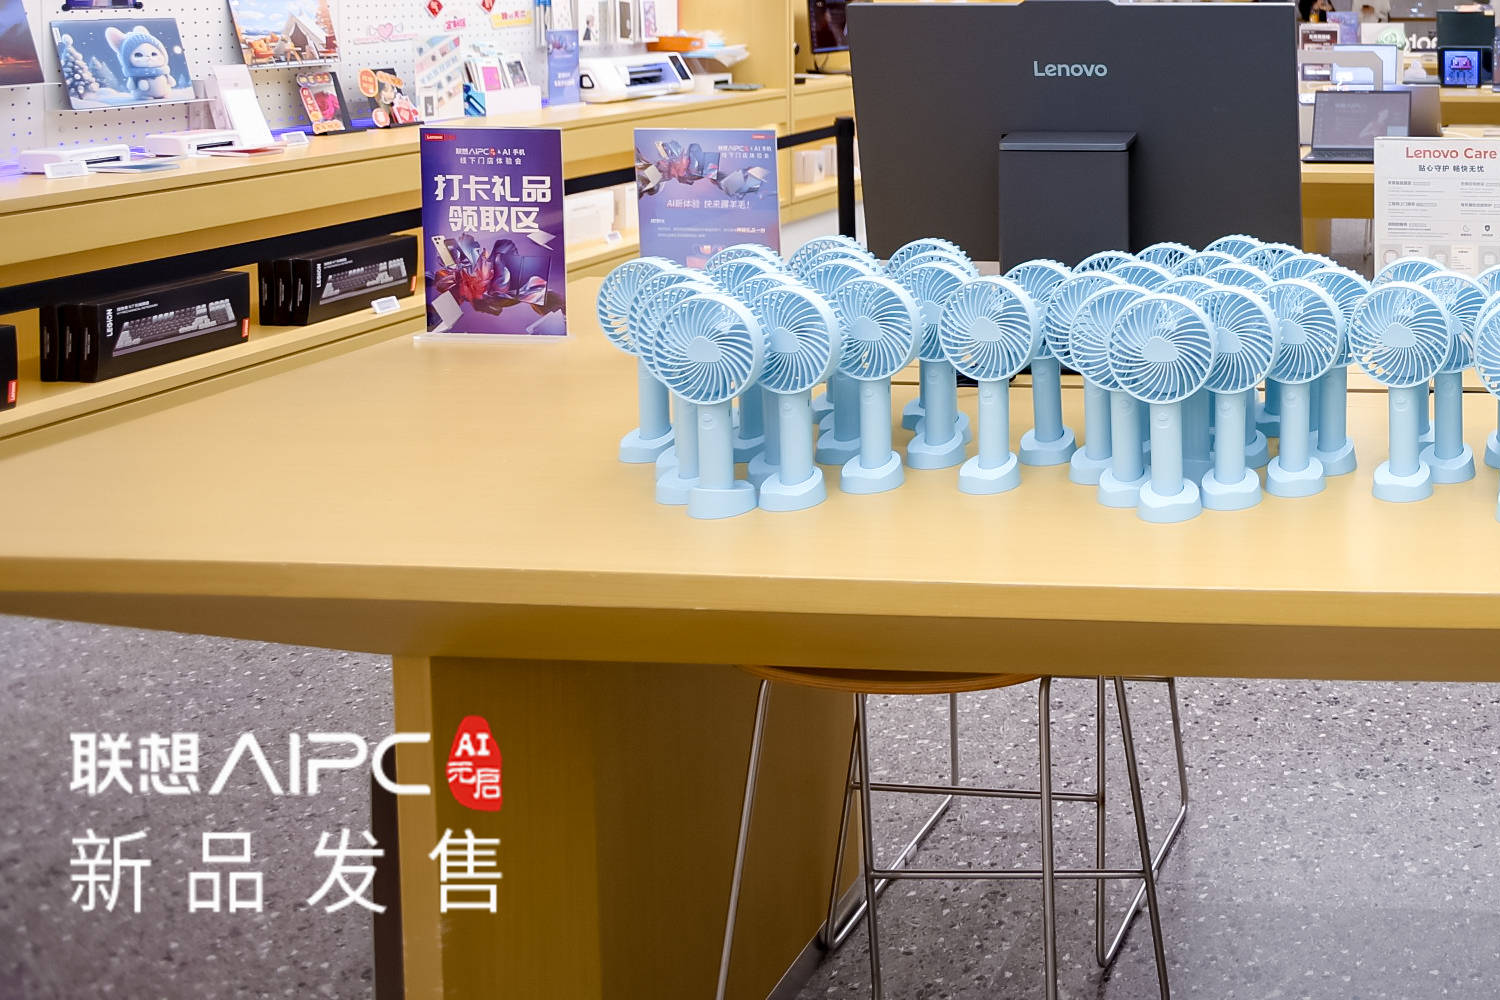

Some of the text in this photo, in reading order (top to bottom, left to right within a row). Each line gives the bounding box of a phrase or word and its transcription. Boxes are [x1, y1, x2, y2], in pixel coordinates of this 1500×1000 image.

[1033, 60, 1108, 77] Lenovo
[502, 148, 511, 156] AI
[1405, 147, 1498, 159] Lenovo Care
[434, 174, 551, 203] 打卡礼品
[448, 205, 540, 233] 领取区
